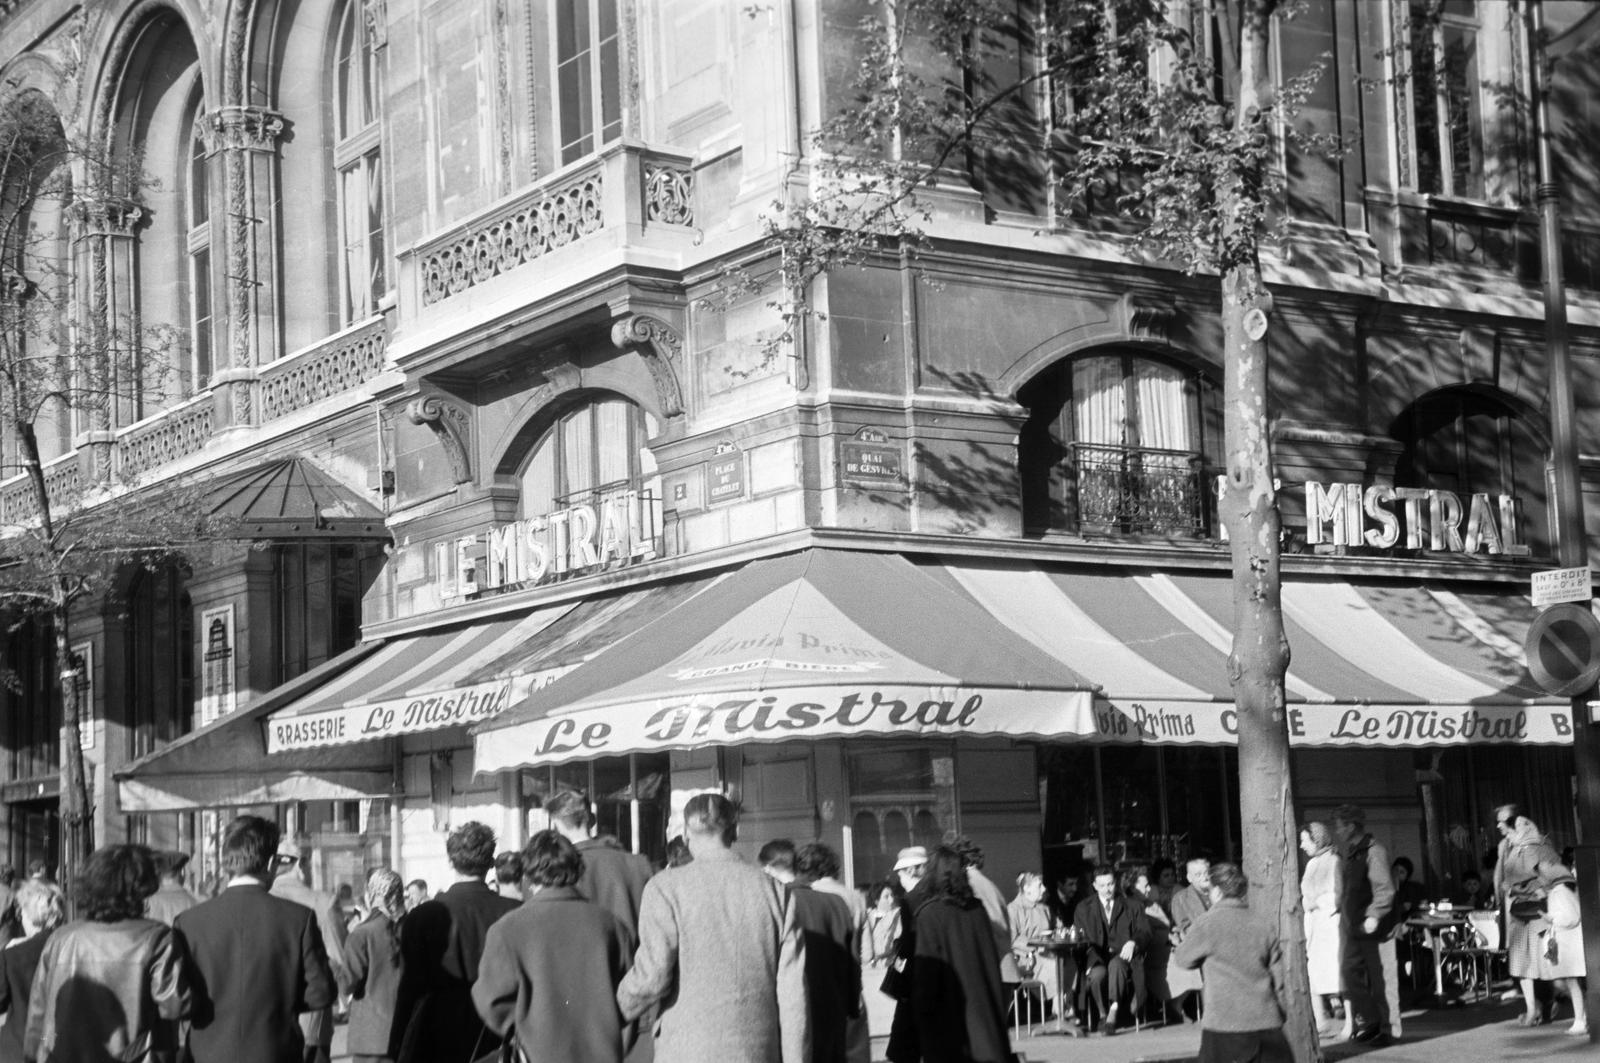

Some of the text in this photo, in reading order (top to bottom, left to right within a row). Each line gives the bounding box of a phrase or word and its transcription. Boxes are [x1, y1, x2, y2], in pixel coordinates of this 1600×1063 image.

[715, 463, 735, 476] PLACE
[847, 463, 859, 473] DE
[862, 453, 882, 463] QUAI
[676, 486, 683, 499] 2
[1305, 480, 1532, 555] MISTRAL
[436, 490, 657, 599] LE MISTRAL
[1536, 570, 1586, 582] INTERDIT
[277, 715, 346, 746] BRASSERIE
[361, 706, 395, 735] Le
[402, 684, 511, 728] Mistral
[534, 692, 983, 755] Le Mistral
[1131, 703, 1196, 741] Prima
[1330, 709, 1528, 740] Le Mistral
